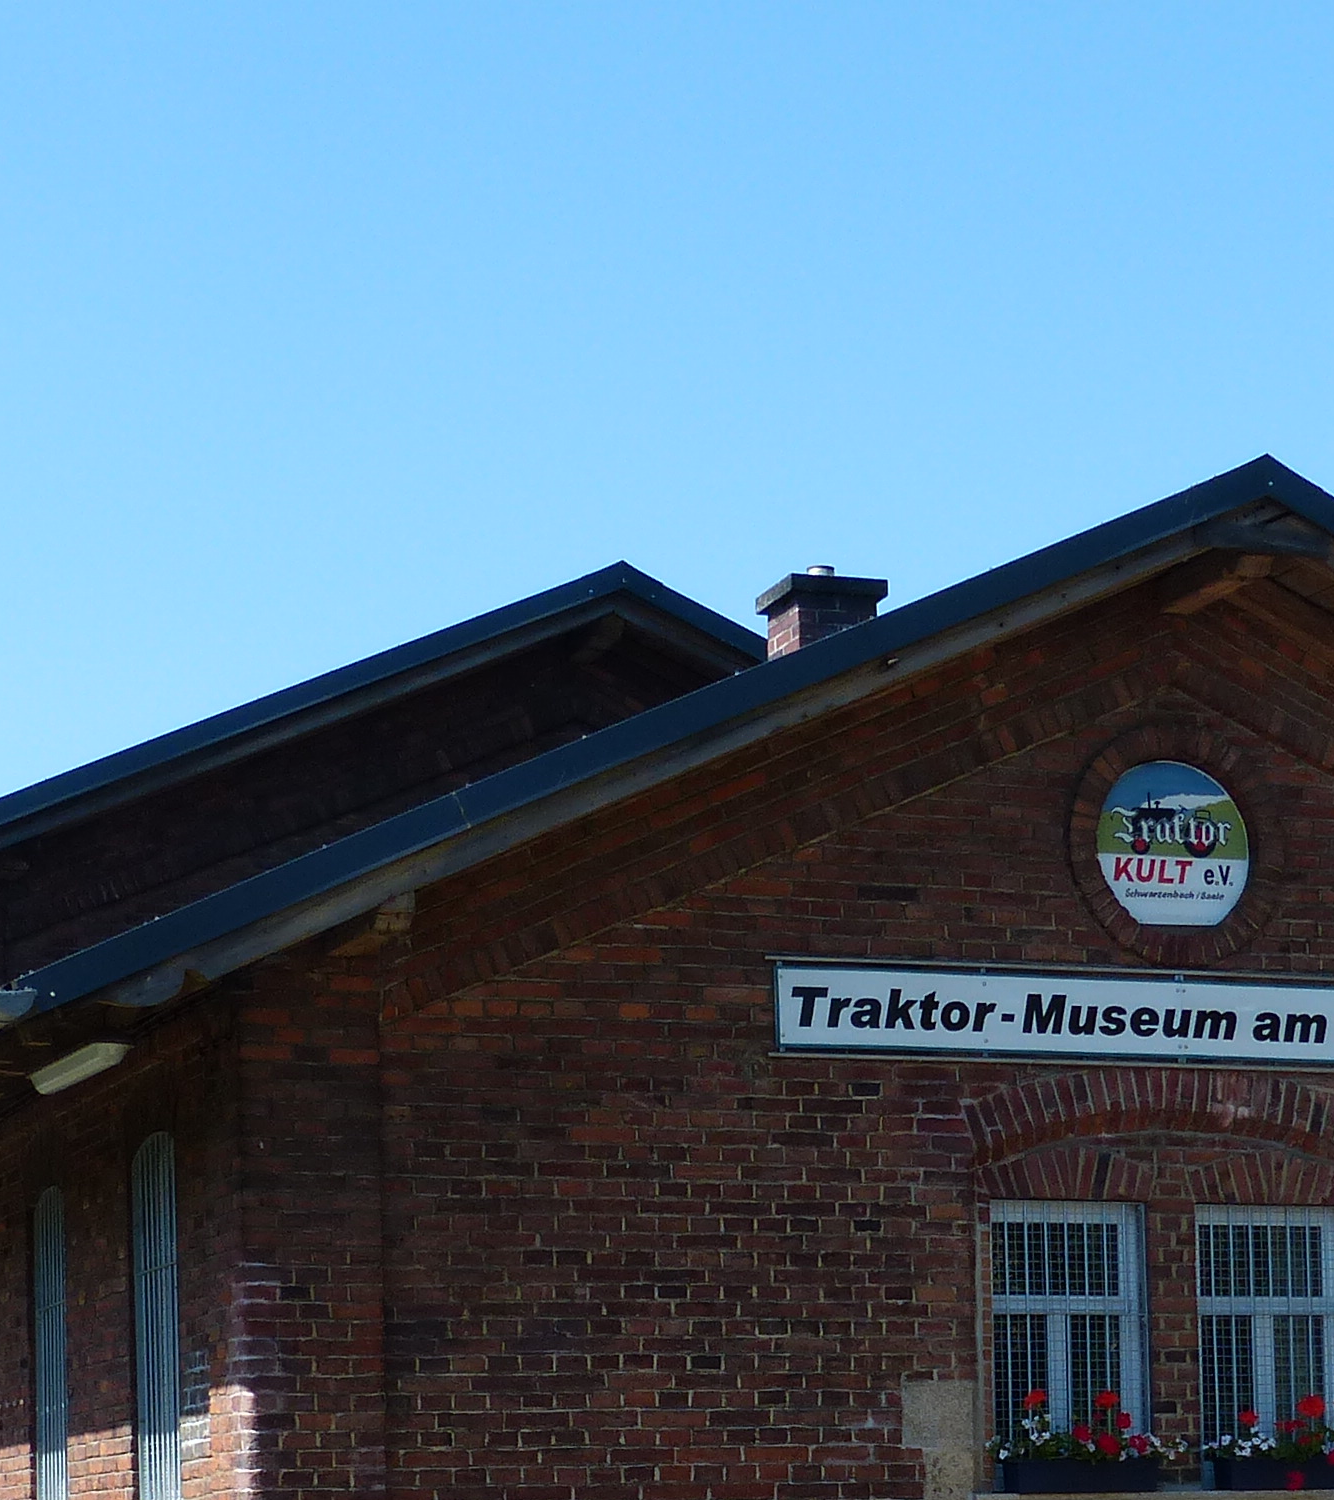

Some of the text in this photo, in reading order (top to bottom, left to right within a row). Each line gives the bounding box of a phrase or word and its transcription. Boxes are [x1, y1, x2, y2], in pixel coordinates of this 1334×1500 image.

[1111, 806, 1231, 847] Traktor
[1113, 856, 1234, 886] KULT e.V.
[791, 986, 1237, 1040] Traktor-Museum
[1252, 1010, 1328, 1044] am
